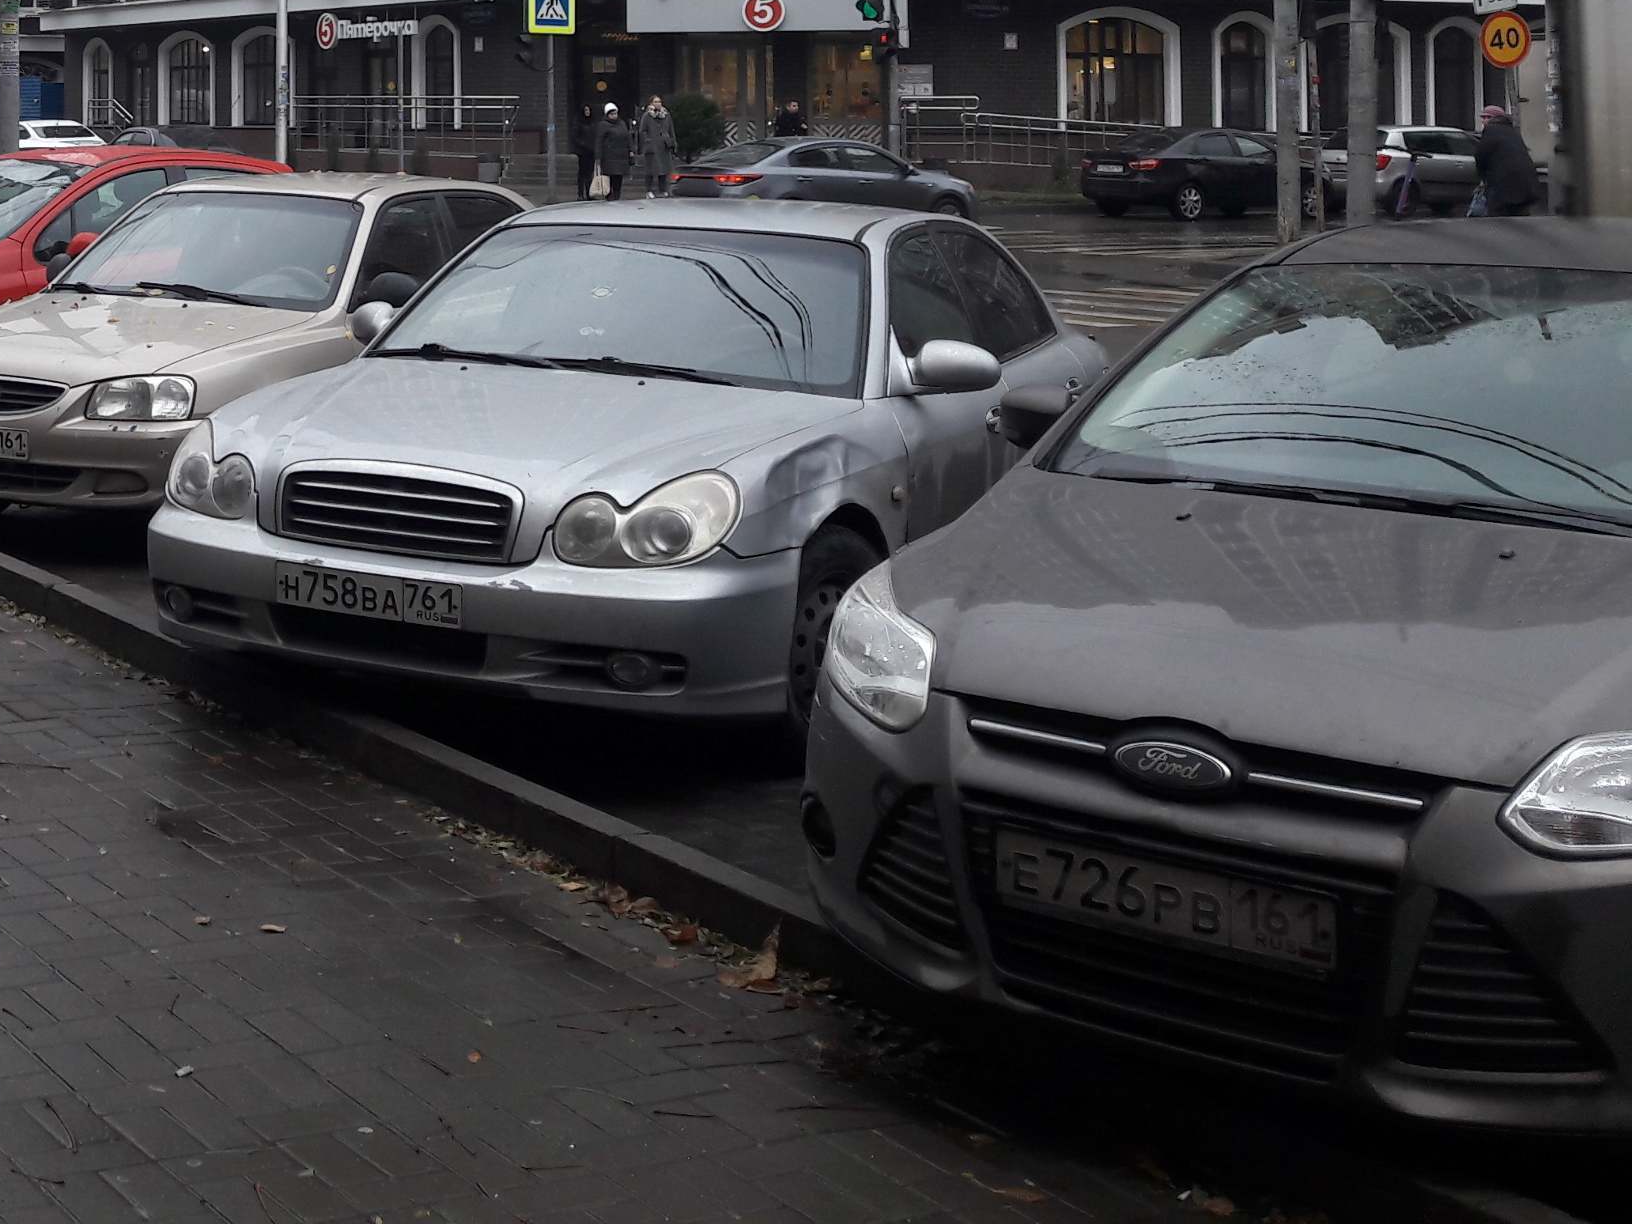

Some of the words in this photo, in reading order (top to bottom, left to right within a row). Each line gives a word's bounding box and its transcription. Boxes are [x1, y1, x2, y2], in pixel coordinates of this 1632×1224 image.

[337, 16, 418, 42] Пятёрочка
[1489, 28, 1520, 50] 40
[283, 570, 399, 616] Н758ВА
[405, 583, 453, 613] 761
[416, 610, 440, 622] RUS
[1138, 747, 1203, 780] Ford
[1013, 847, 1221, 934] Е726РВ
[1237, 887, 1320, 943] 161
